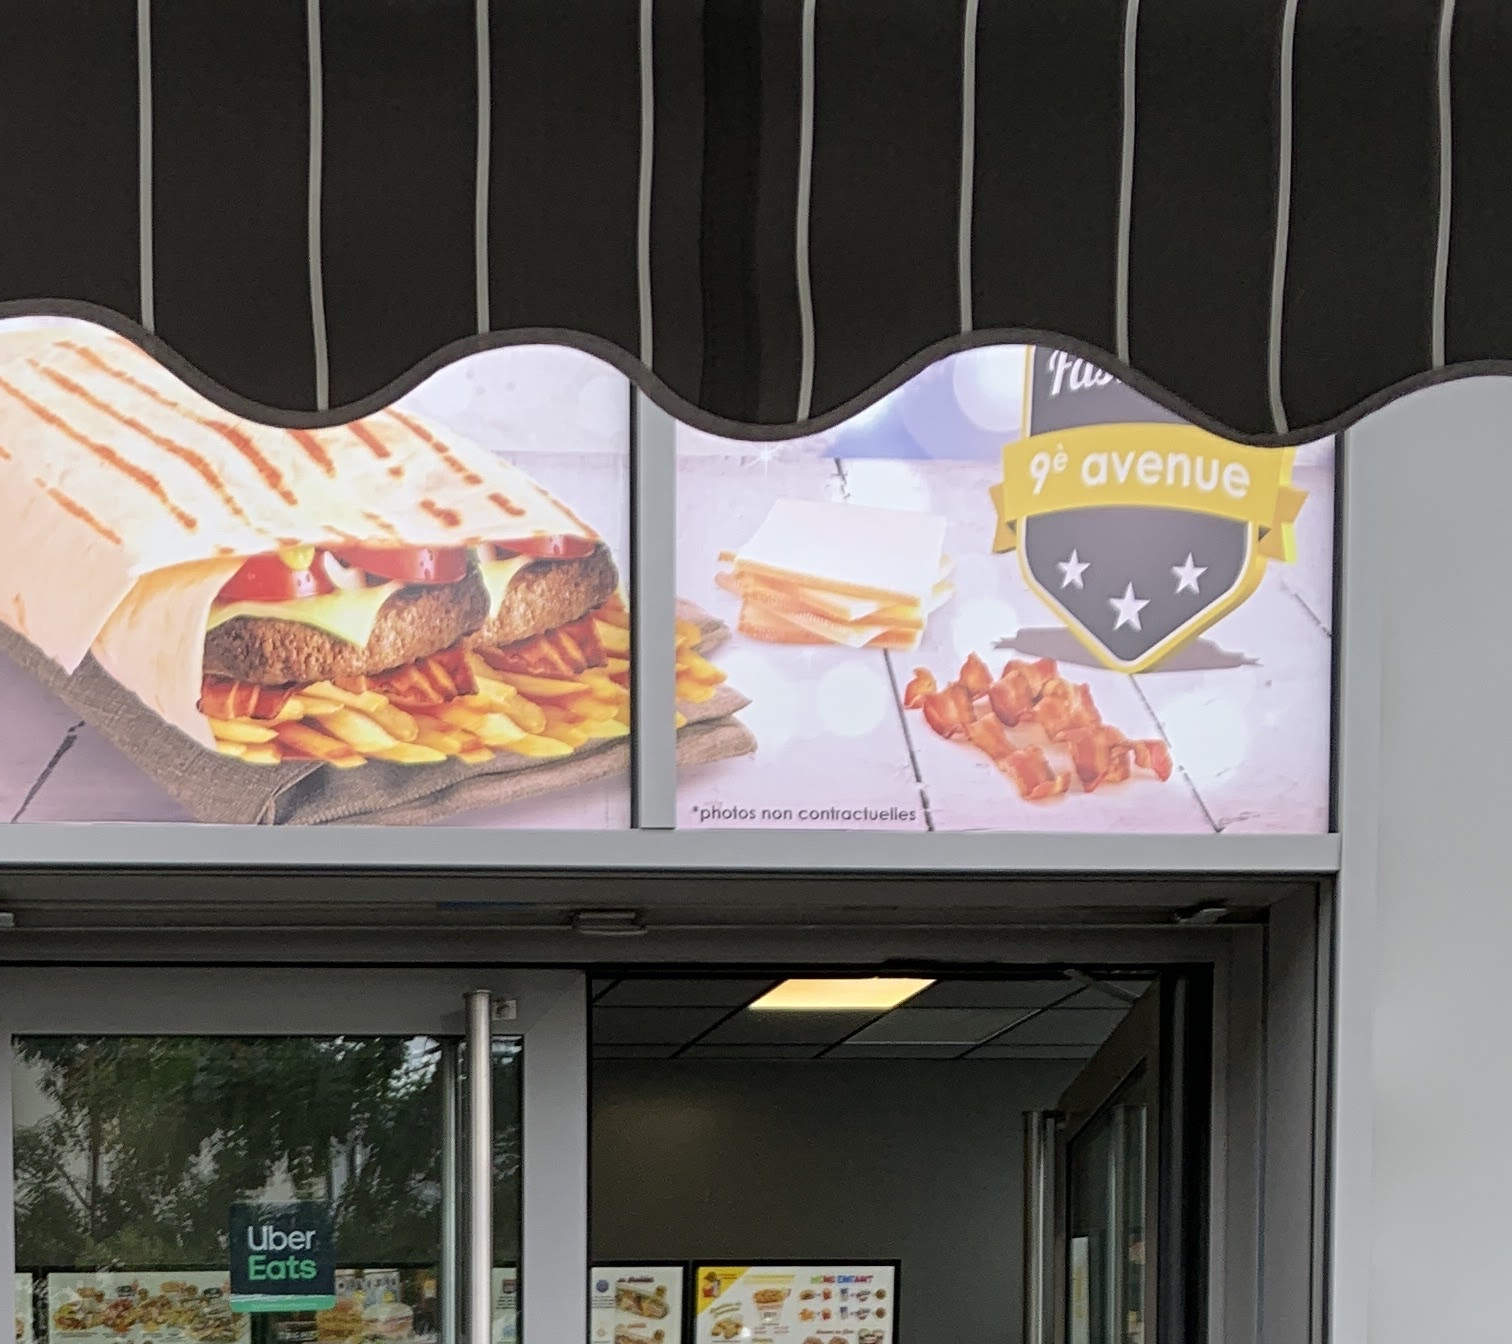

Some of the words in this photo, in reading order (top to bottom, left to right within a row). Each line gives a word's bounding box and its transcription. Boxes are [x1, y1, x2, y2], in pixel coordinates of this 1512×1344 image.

[1081, 451, 1251, 498] avenue
[761, 809, 793, 821] non
[798, 807, 917, 821] contractuelles
[248, 1225, 317, 1251] Uber
[249, 1255, 318, 1280] Eats
